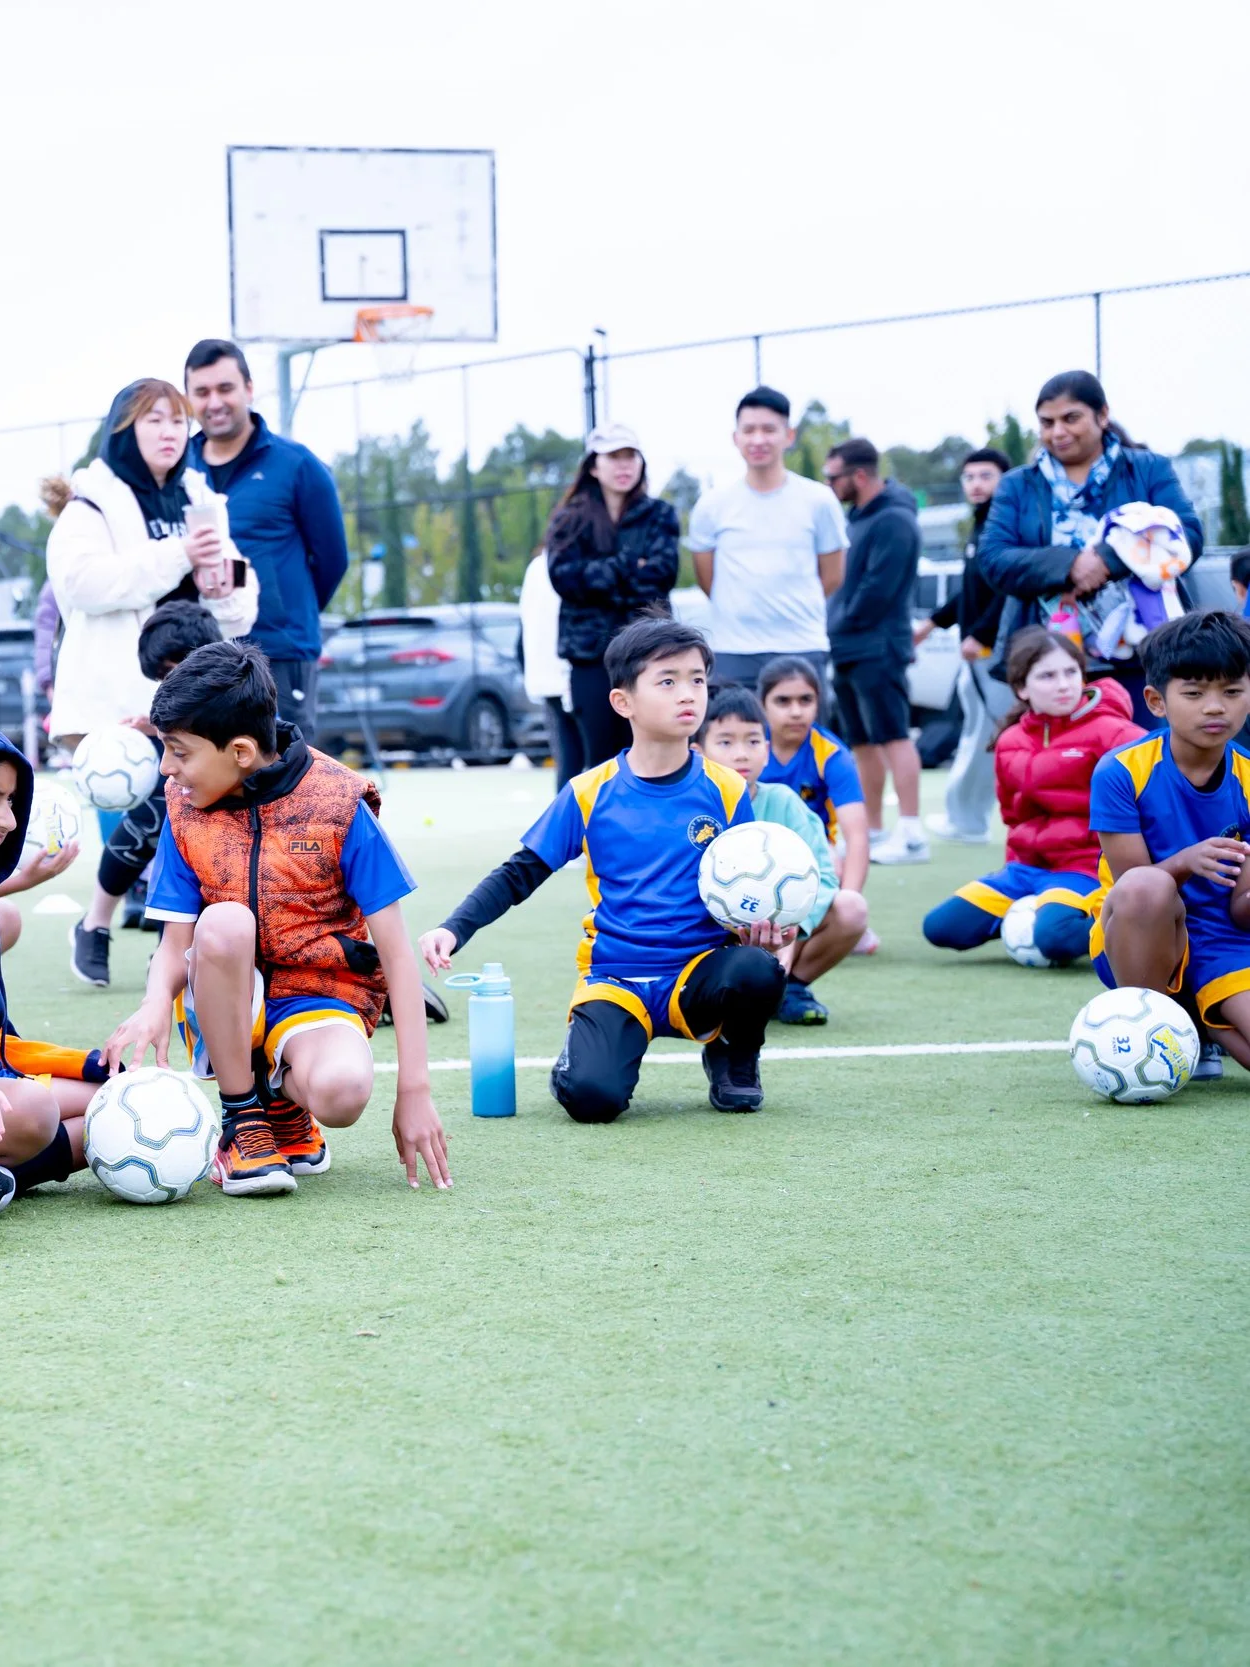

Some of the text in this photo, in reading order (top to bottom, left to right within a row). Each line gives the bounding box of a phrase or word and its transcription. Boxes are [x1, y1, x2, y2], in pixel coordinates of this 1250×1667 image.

[291, 842, 320, 851] FILA
[740, 898, 759, 912] 32
[1117, 1036, 1131, 1054] 32
